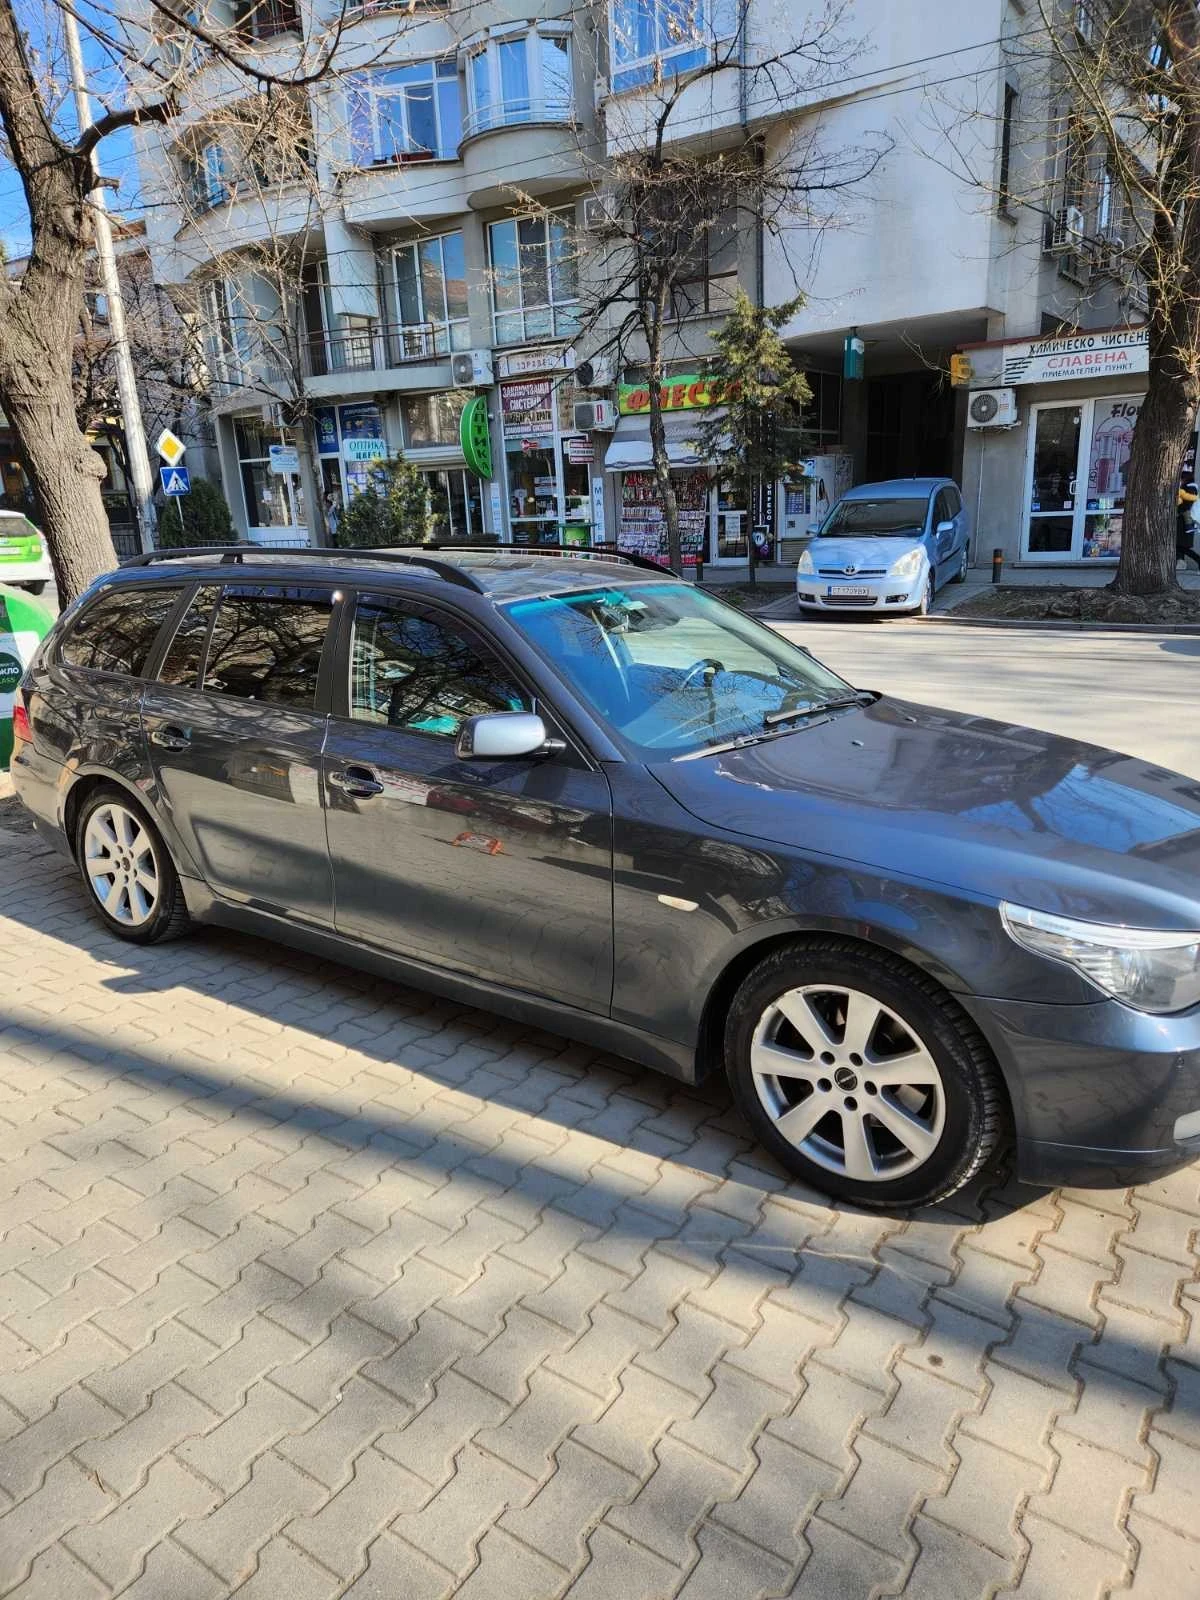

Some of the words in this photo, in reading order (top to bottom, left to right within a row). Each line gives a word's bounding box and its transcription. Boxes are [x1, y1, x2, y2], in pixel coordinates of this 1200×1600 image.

[1029, 337, 1095, 355] ХИМИЧЕСКО
[1047, 351, 1128, 368] СЛАВЕНА
[1042, 367, 1101, 378] ПРИЕМАТЕЛЕН
[1104, 362, 1134, 371] ПУНКТ
[474, 402, 489, 470] ОПТИКА
[349, 441, 384, 451] ОПТИКА
